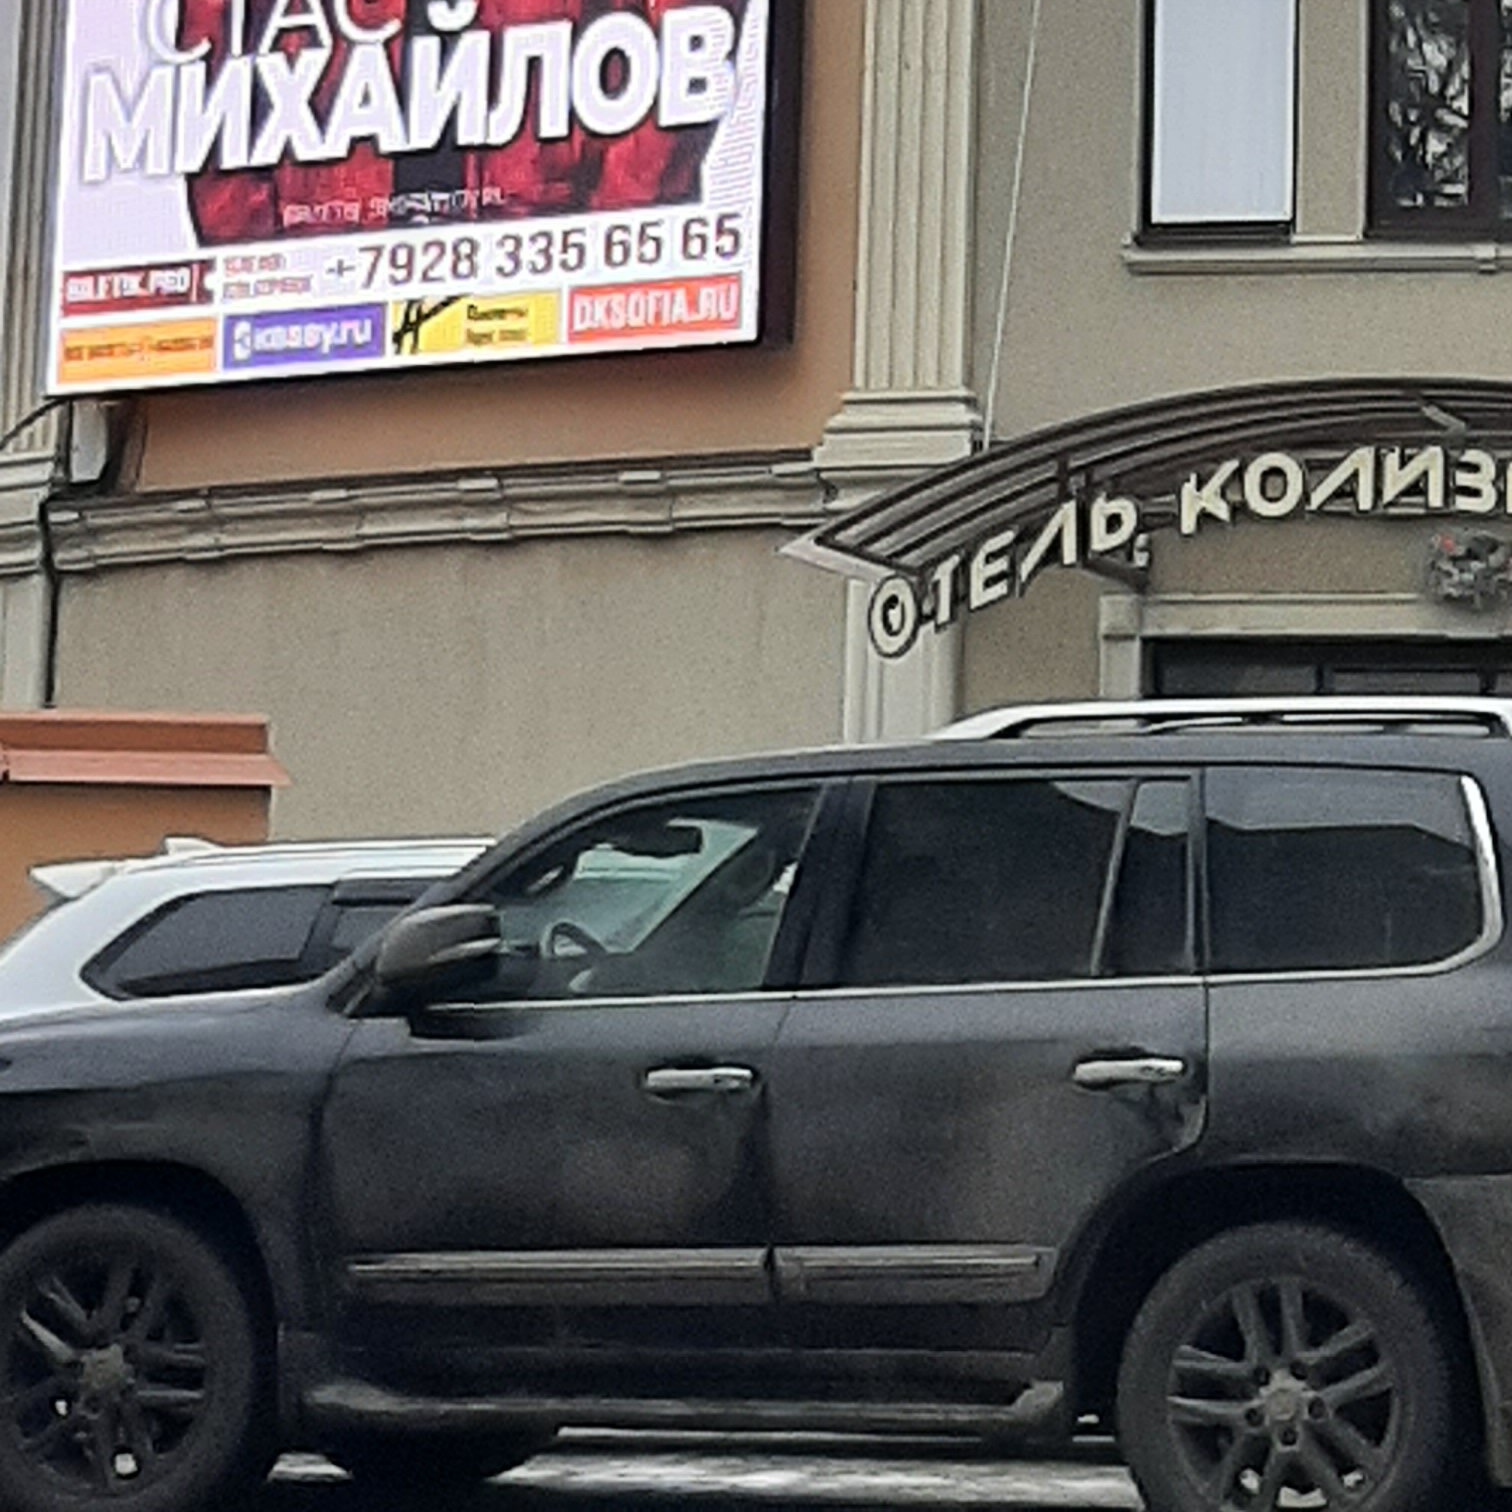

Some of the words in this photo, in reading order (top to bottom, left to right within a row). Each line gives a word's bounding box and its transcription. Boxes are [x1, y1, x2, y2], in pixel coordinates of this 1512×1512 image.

[495, 227, 587, 278] 335
[603, 219, 664, 268] 65
[681, 213, 743, 261] 65
[868, 491, 1140, 658] ОТЕЛЬ
